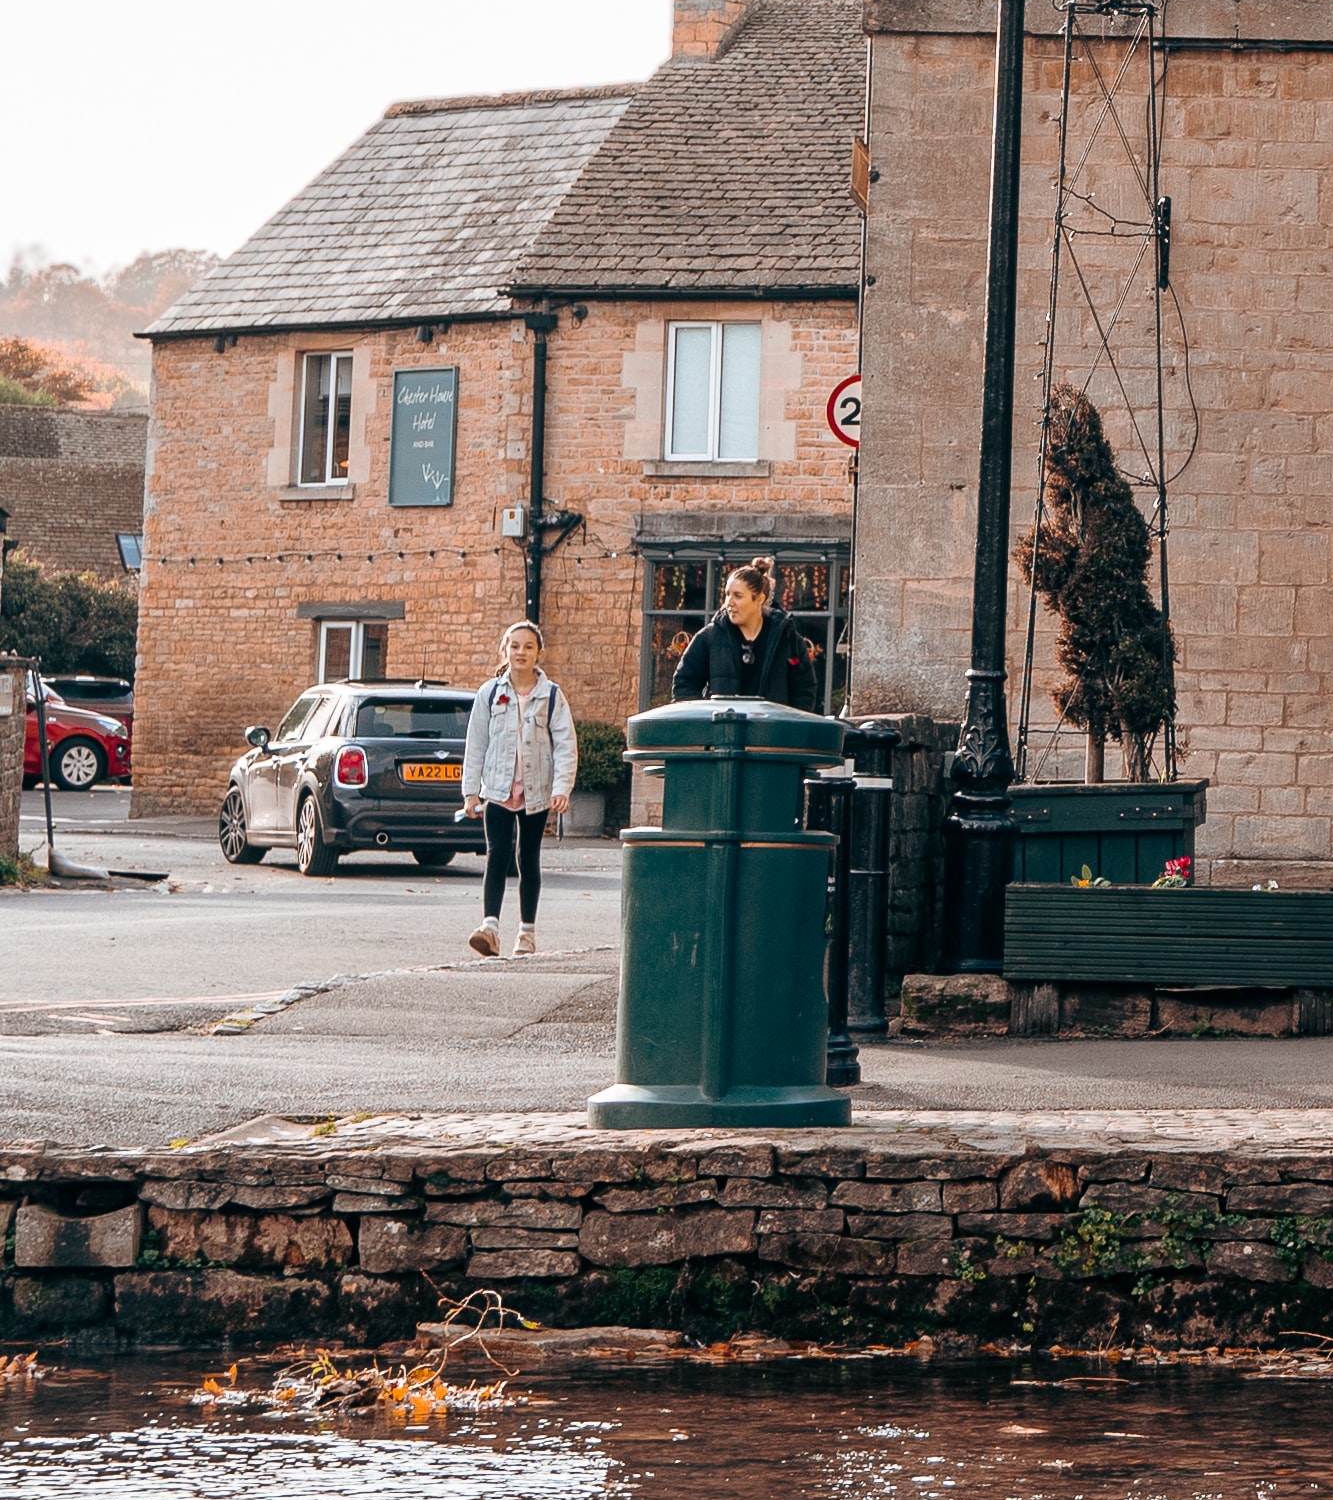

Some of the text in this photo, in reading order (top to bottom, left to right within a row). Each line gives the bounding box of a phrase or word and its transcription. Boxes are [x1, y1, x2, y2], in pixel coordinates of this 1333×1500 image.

[397, 384, 454, 406] Chester House
[412, 411, 437, 431] Hotel
[840, 397, 861, 426] 2
[409, 766, 463, 779] YA22 LG
